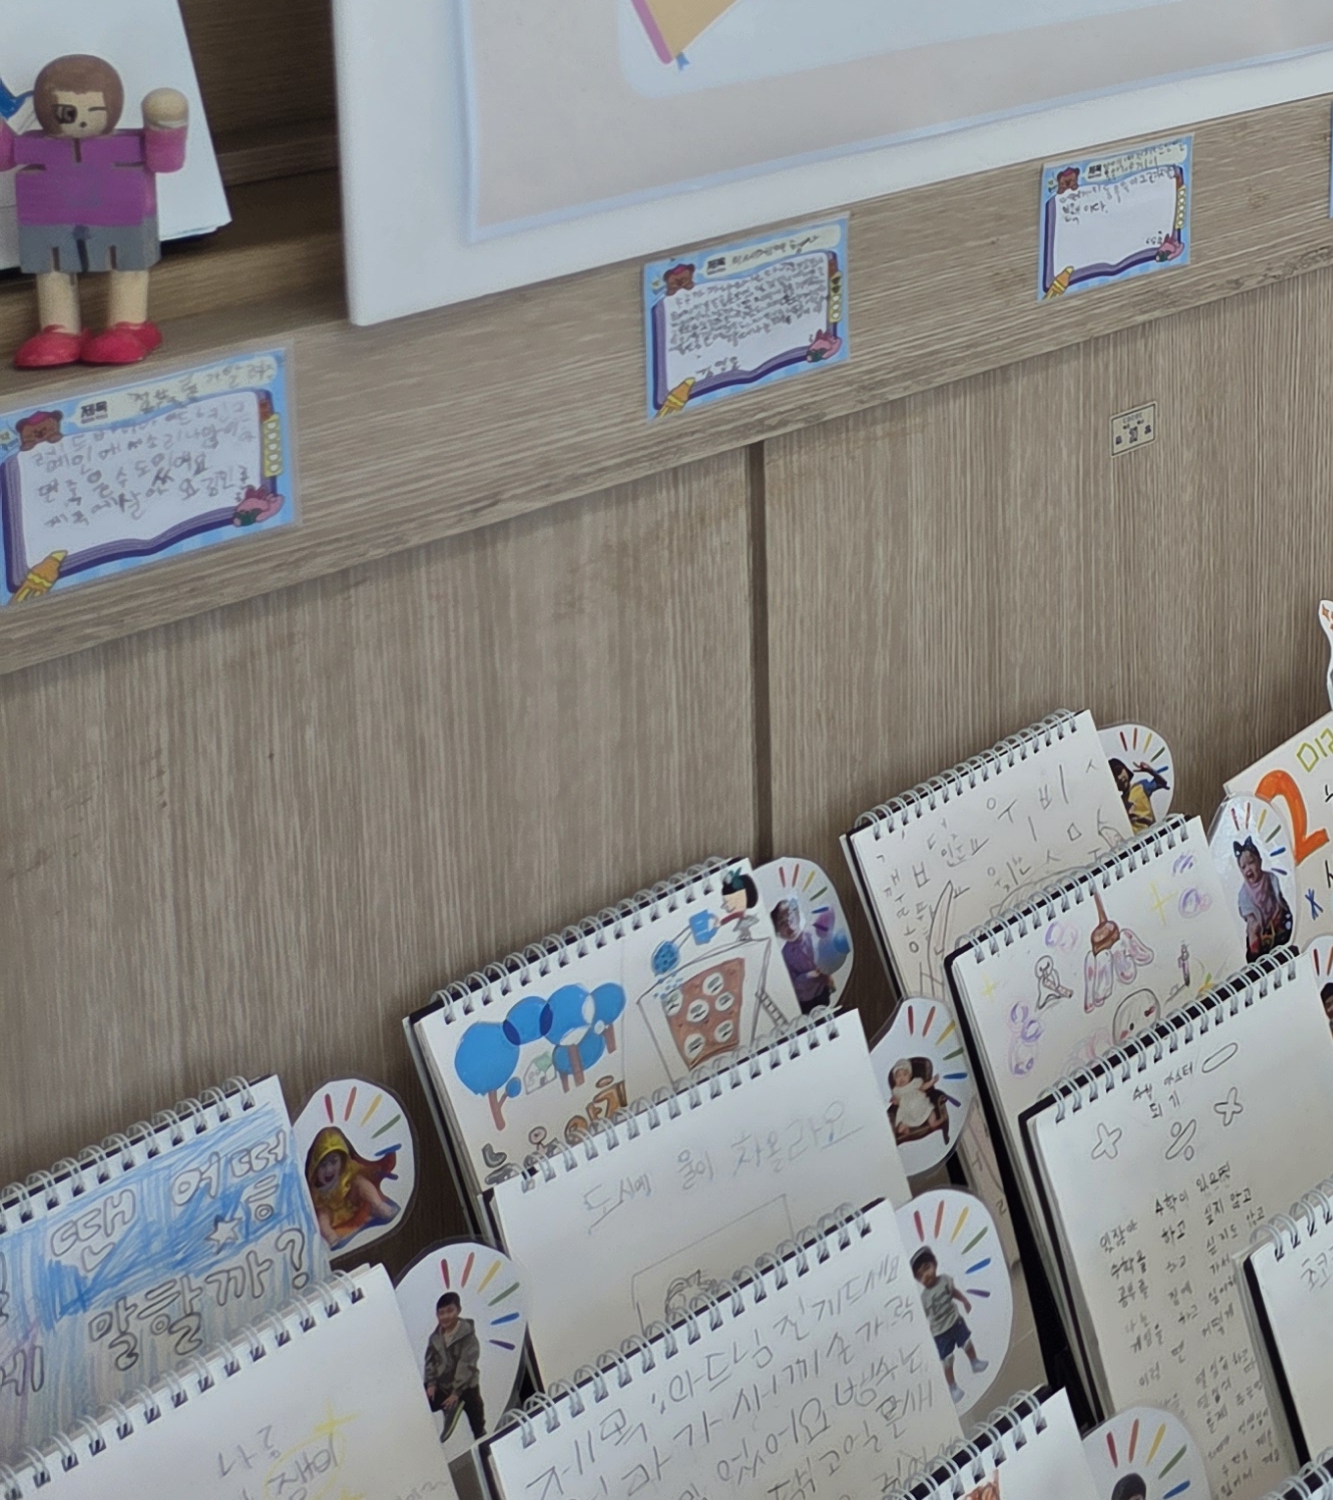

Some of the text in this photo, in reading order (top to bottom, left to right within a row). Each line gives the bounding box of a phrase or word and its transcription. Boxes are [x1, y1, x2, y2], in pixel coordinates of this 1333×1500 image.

[1254, 770, 1330, 867] 2
[1161, 1220, 1187, 1246] 하고
[88, 1227, 312, 1372] 말할까?
